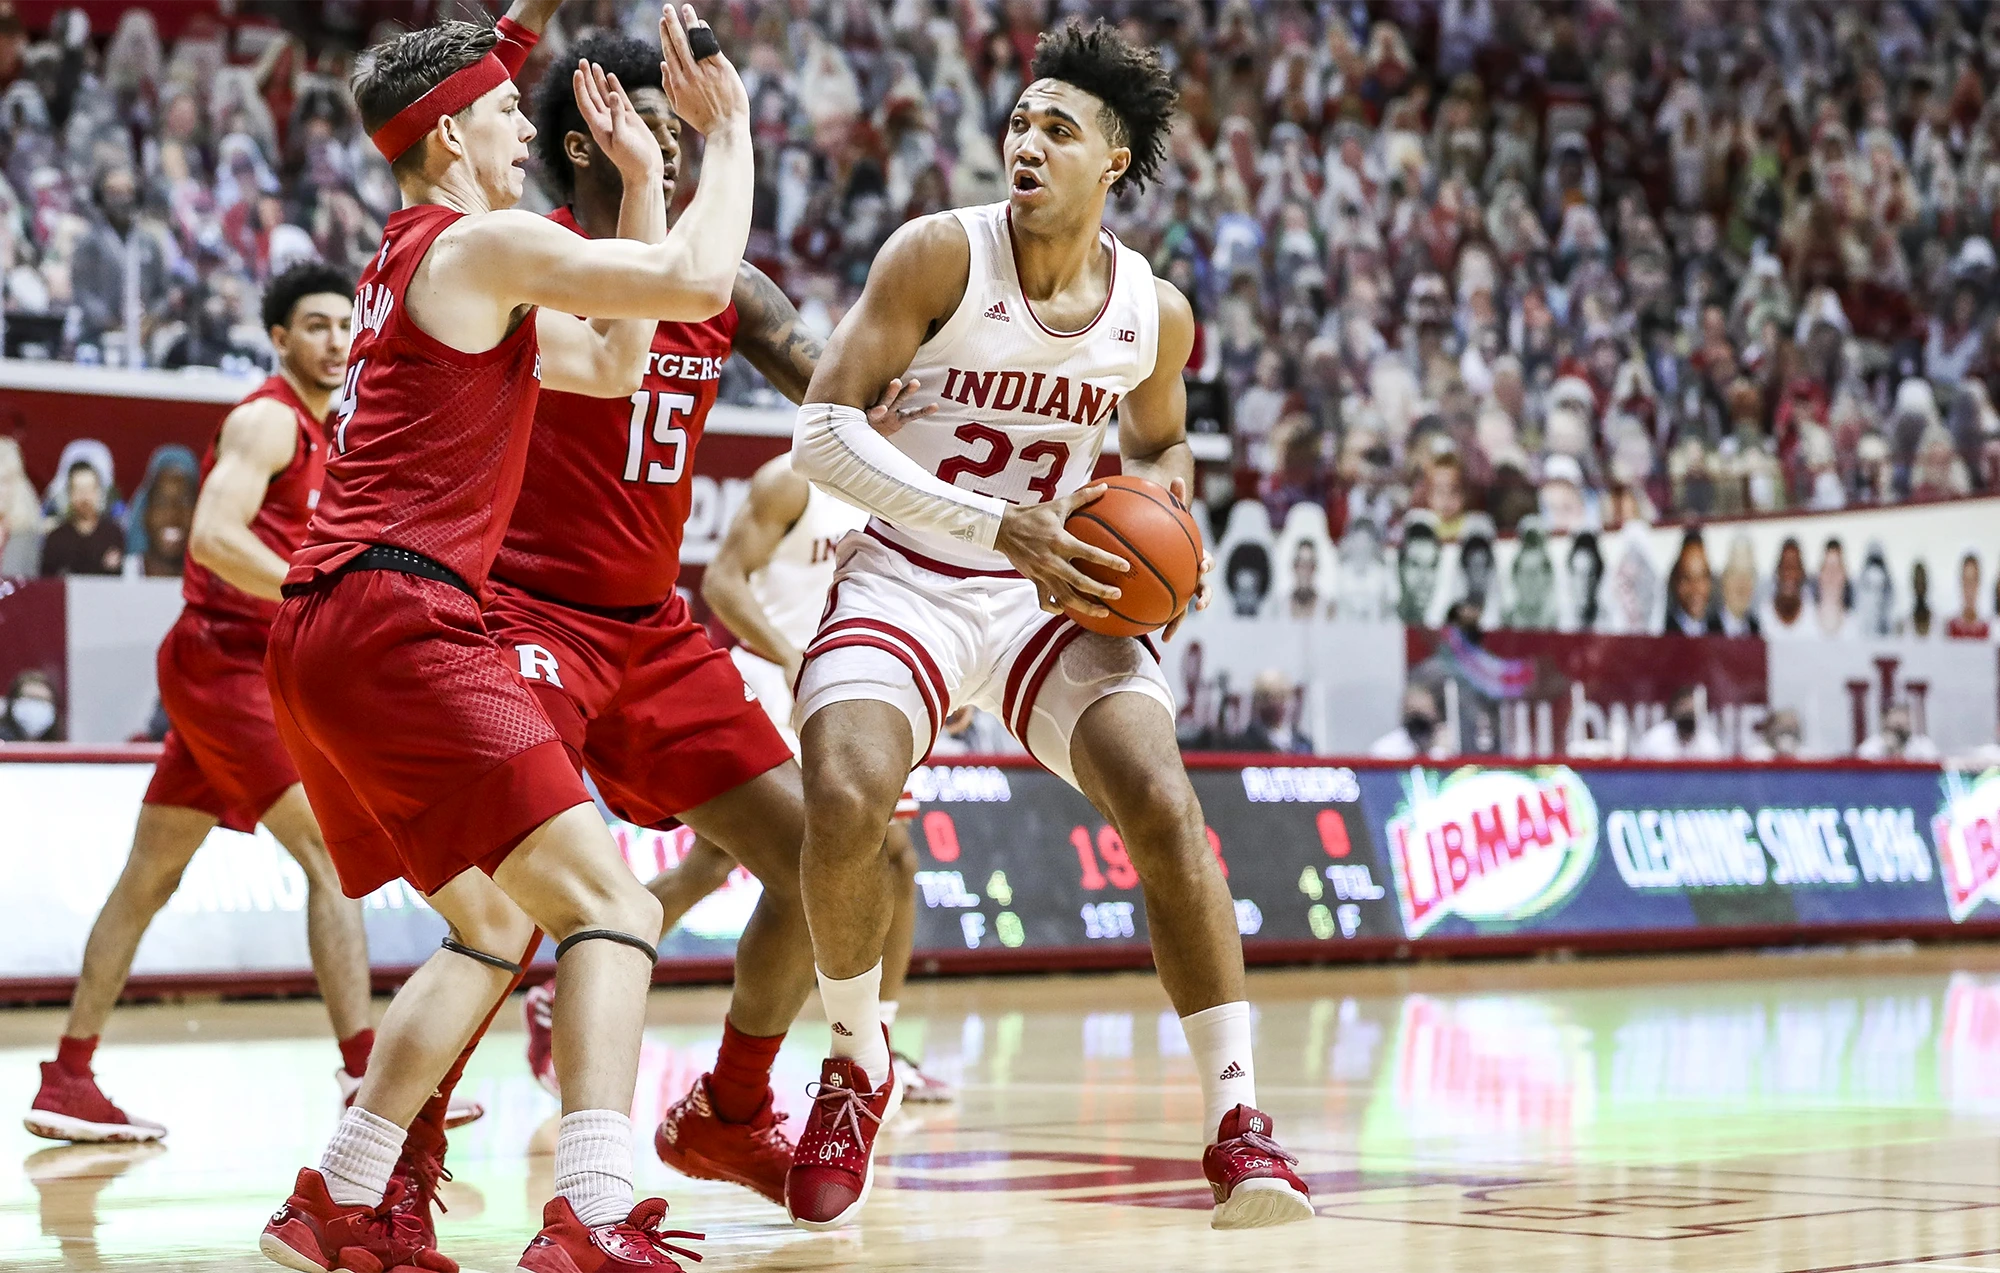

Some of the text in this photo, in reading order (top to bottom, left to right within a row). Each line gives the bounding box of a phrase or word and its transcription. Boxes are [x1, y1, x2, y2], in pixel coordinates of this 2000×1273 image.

[983, 311, 1010, 323] adidas
[644, 351, 723, 381] TGERS
[623, 389, 696, 484] 15
[935, 421, 1071, 505] 23
[514, 643, 564, 689] R
[922, 810, 962, 863] 0
[1315, 808, 1352, 859] 0
[1395, 784, 1582, 922] LIBMAN
[1219, 1069, 1246, 1081] adidas
